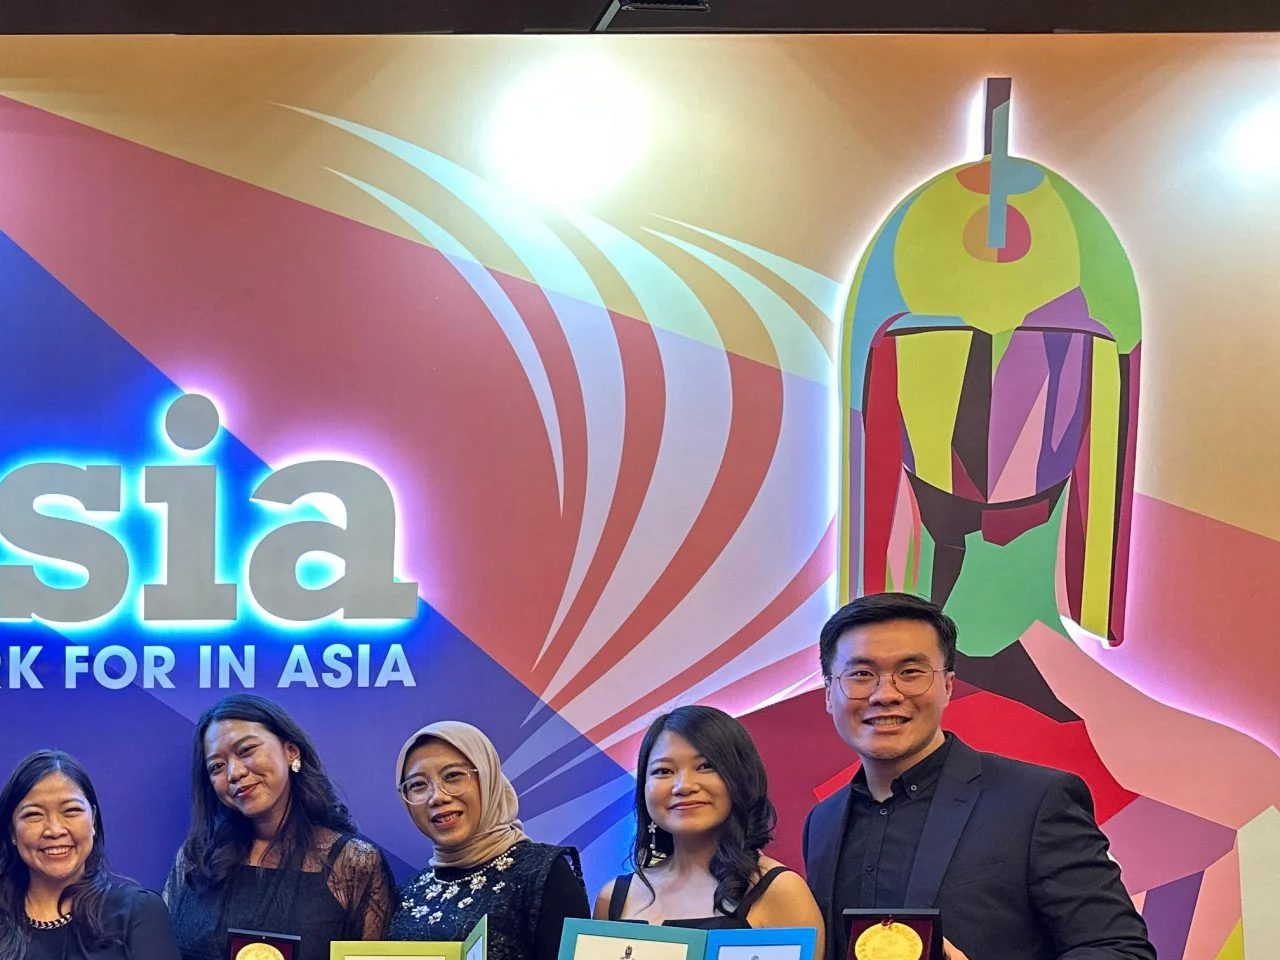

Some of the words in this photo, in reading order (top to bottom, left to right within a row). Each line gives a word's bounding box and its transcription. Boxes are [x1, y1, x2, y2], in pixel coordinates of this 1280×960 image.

[65, 645, 176, 689] FOR
[199, 644, 255, 688] IN
[277, 643, 417, 688] ASIA
